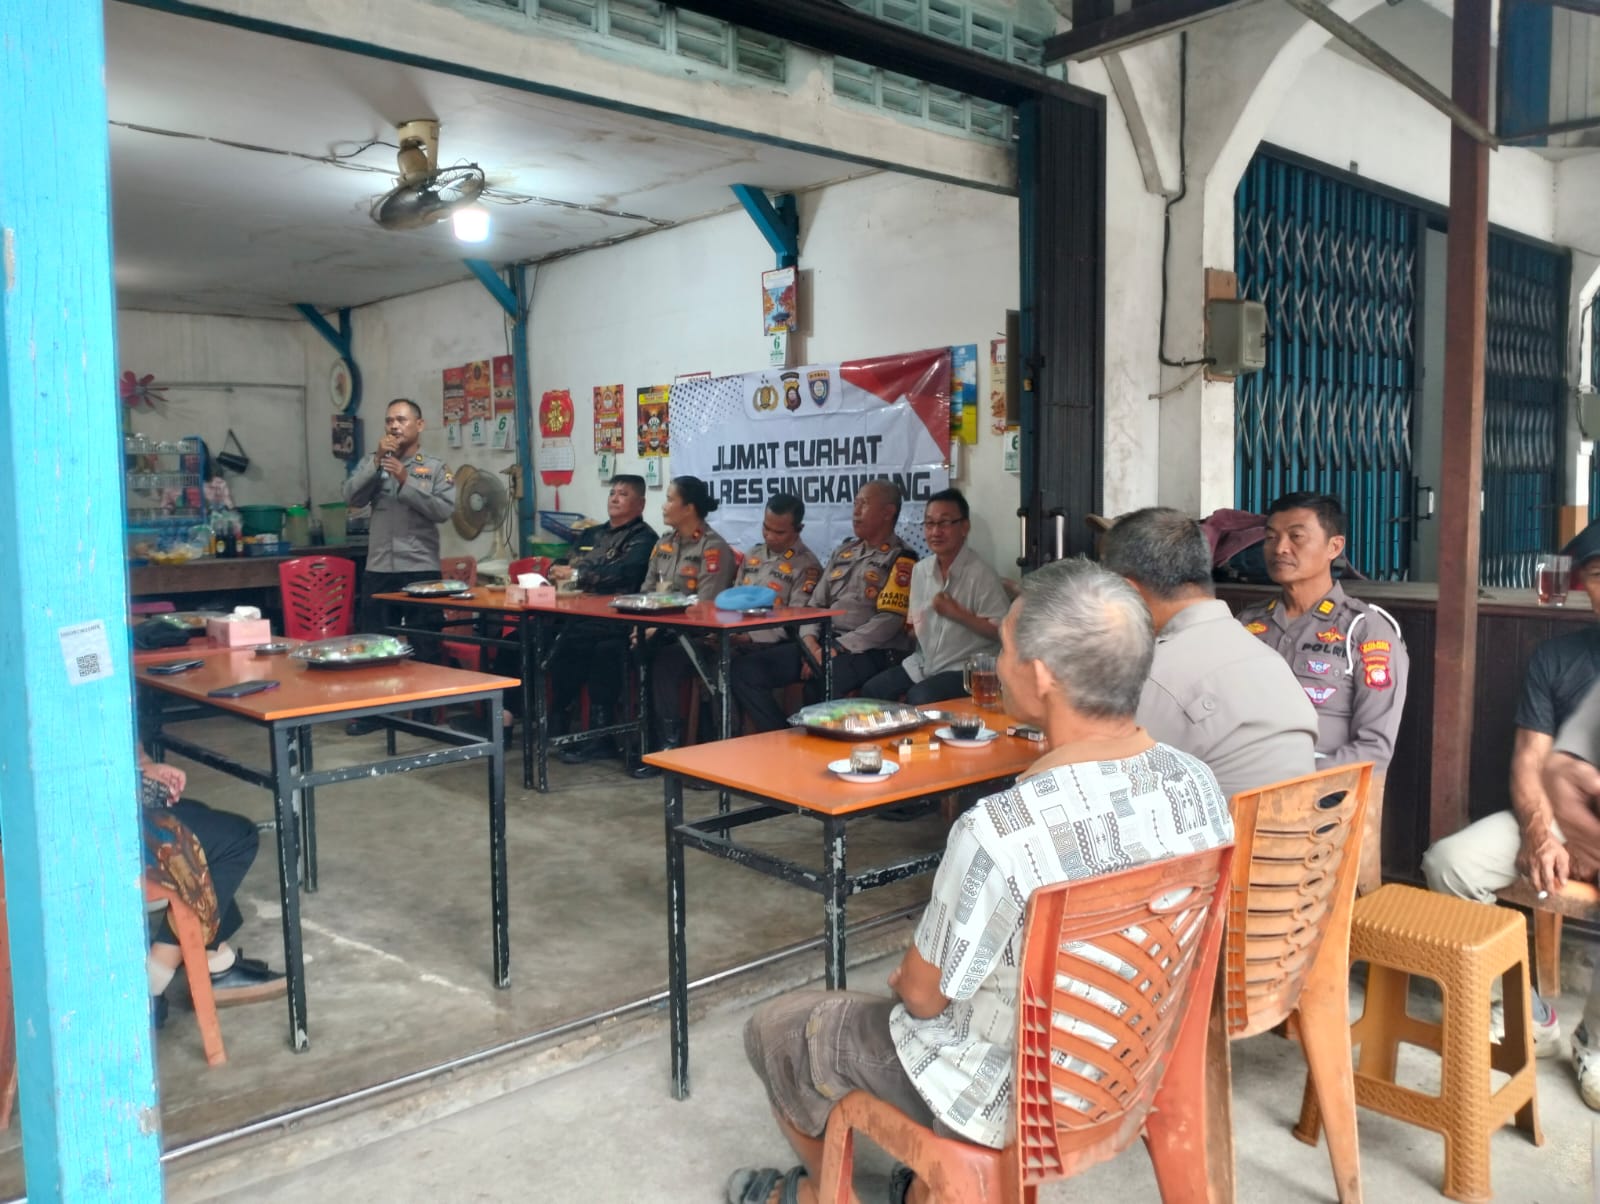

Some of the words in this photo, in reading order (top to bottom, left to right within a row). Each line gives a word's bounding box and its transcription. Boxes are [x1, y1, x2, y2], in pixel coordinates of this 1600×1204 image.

[773, 336, 780, 350] 6
[473, 421, 480, 433] 6
[498, 416, 507, 431] 6
[712, 442, 779, 471] JUMAT
[784, 435, 882, 468] CURHAT
[601, 454, 607, 468] 6
[648, 460, 655, 472] 6
[703, 478, 763, 504] LRES
[766, 471, 931, 503] SINGKANG
